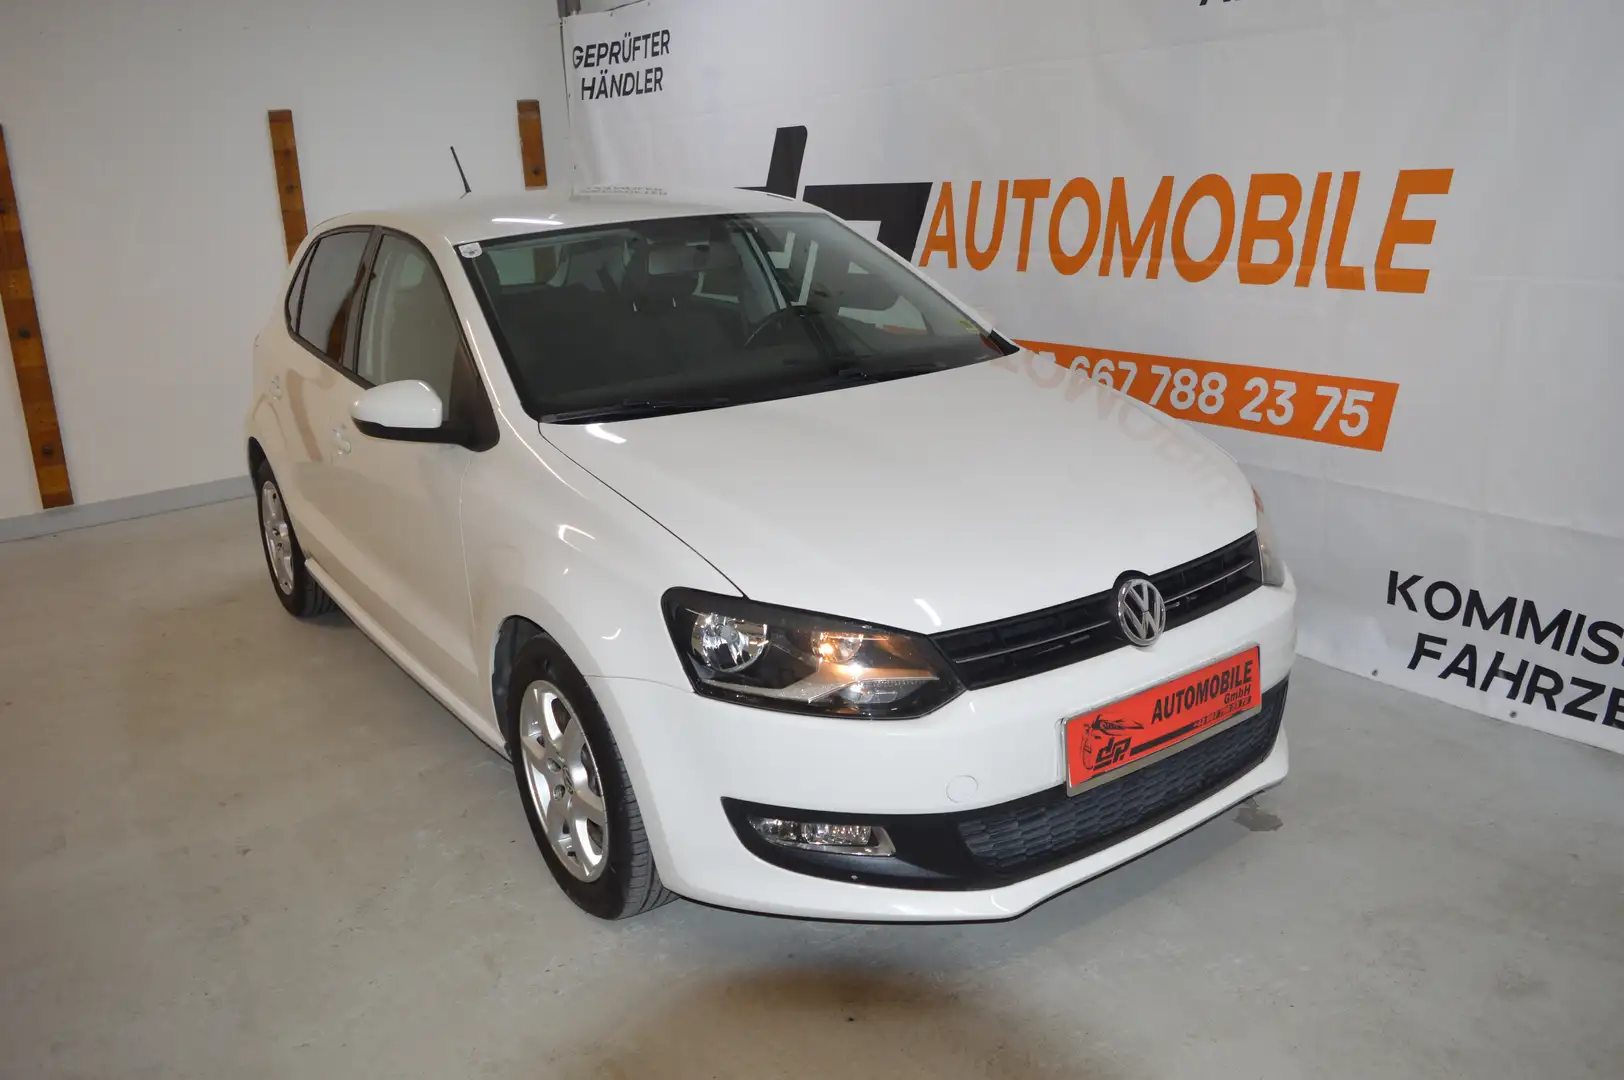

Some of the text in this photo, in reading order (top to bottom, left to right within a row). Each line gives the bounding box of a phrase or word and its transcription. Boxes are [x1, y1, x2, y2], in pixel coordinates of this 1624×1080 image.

[572, 29, 671, 69] GEPRÜFTER
[581, 66, 664, 100] HÄNDLER
[918, 168, 1455, 294] AUTOMOBILE
[1148, 364, 1228, 416] 788
[1238, 376, 1298, 426] 23
[1312, 386, 1375, 437] 75
[1386, 569, 1624, 666] KOMMIS
[1151, 659, 1253, 725] AUTOMOBILE
[1223, 683, 1252, 705] GmbH
[1406, 632, 1624, 731] FAHRZE
